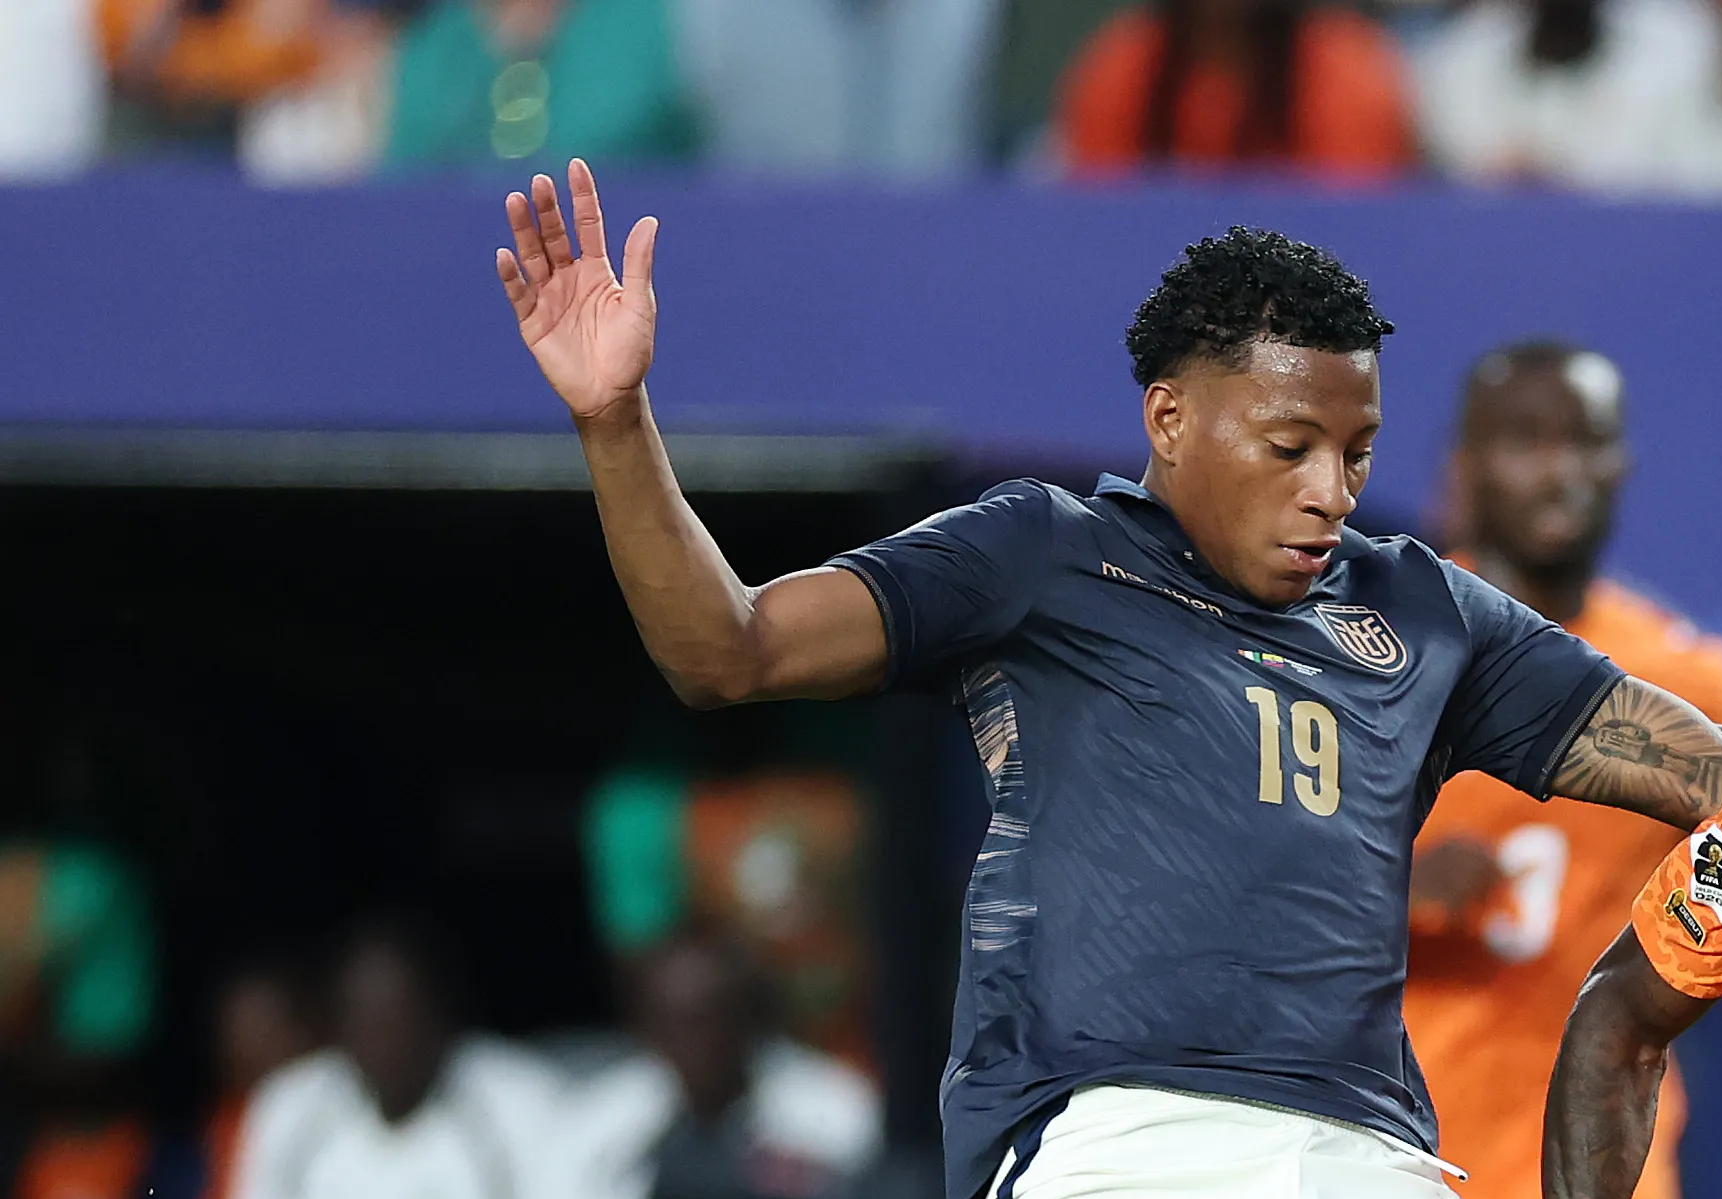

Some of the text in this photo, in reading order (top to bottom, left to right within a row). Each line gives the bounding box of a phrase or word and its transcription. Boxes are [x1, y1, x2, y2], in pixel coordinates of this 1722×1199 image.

[1245, 686, 1340, 817] 19
[1700, 873, 1720, 886] FIFA
[1679, 904, 1703, 937] DEBUT
